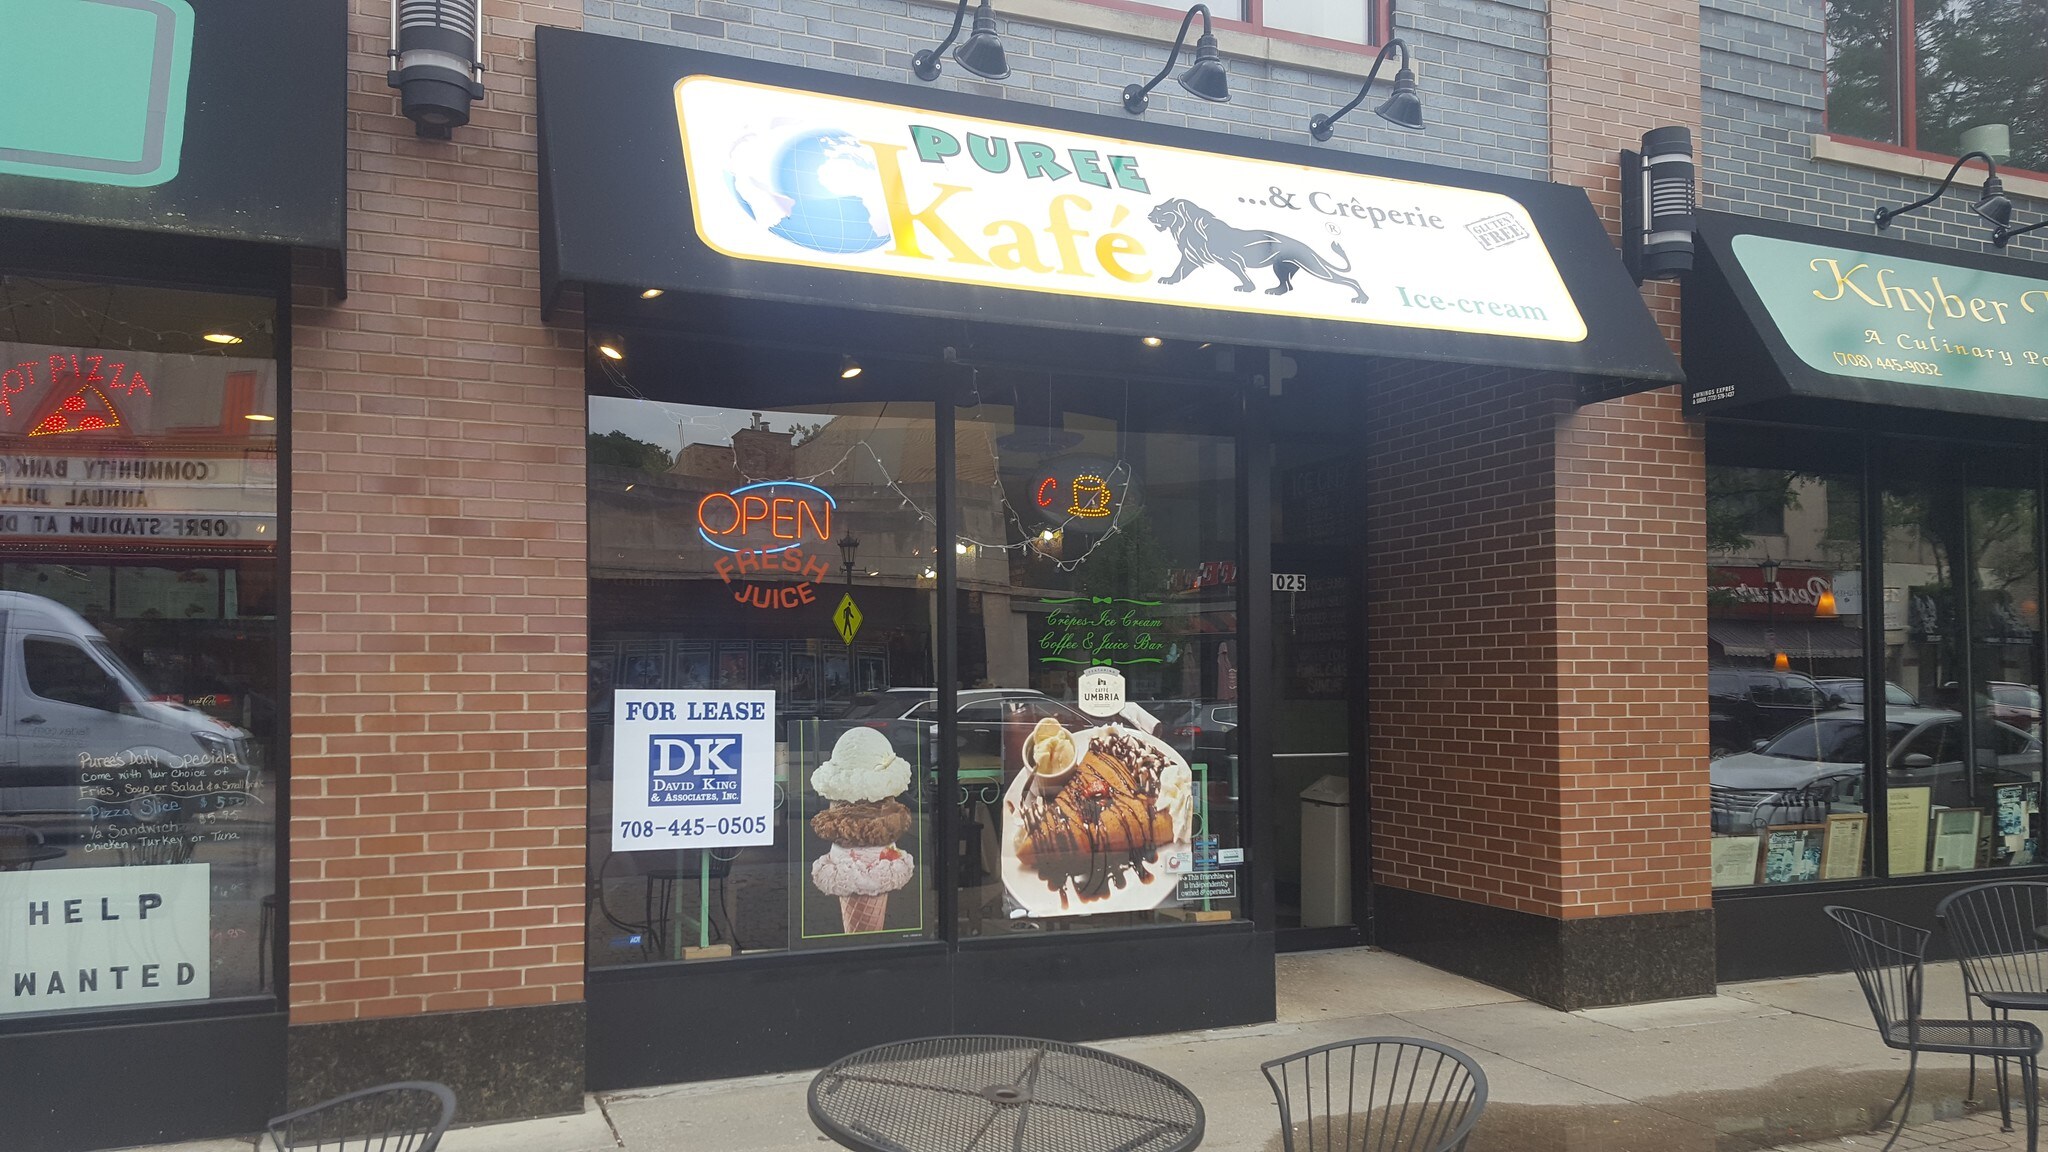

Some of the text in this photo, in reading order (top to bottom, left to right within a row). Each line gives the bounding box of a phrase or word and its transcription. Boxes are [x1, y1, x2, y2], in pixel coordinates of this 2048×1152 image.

[908, 124, 1151, 195] PUREE
[858, 139, 1153, 283] Kafé
[1308, 191, 1445, 230] Crêperie
[1472, 217, 1512, 234] GLUTEN
[1479, 223, 1524, 247] FREE
[1395, 286, 1549, 321] Ice-cream
[1810, 258, 2009, 330] Khyber
[1864, 330, 1885, 345] A
[1897, 333, 2014, 367] Culinary
[50, 354, 151, 396] PIZZA
[1832, 352, 1943, 376] (708) 445-9032
[698, 493, 830, 540] OPEN
[714, 544, 830, 584] FRESH
[734, 581, 816, 609] JUICE
[1121, 609, 1162, 627] Cream
[1039, 632, 1164, 655] Coffee & Juice Bar
[1084, 693, 1120, 701] UMBRIA
[625, 702, 766, 721] FOR LEASE
[78, 748, 238, 769] Puree's Daily Specials
[653, 738, 738, 776] DK
[81, 772, 114, 782] Come
[119, 769, 142, 779] with
[171, 768, 207, 779] Choice
[214, 766, 230, 775] of
[79, 785, 120, 798] Fries,
[124, 784, 150, 798] Soup
[154, 783, 166, 792] or
[171, 780, 205, 792] Salad
[651, 793, 661, 802] &
[86, 805, 132, 821] Pizza
[140, 799, 182, 816] Slice
[108, 823, 179, 839] Sandwich
[138, 834, 183, 847] Turkey
[192, 834, 205, 843] or
[211, 830, 241, 842] Tuna
[620, 816, 766, 838] 708-445-0505
[1189, 880, 1229, 889] independently
[1200, 873, 1225, 881] franchise
[29, 893, 163, 925] HELP
[14, 962, 195, 997] WANTED
